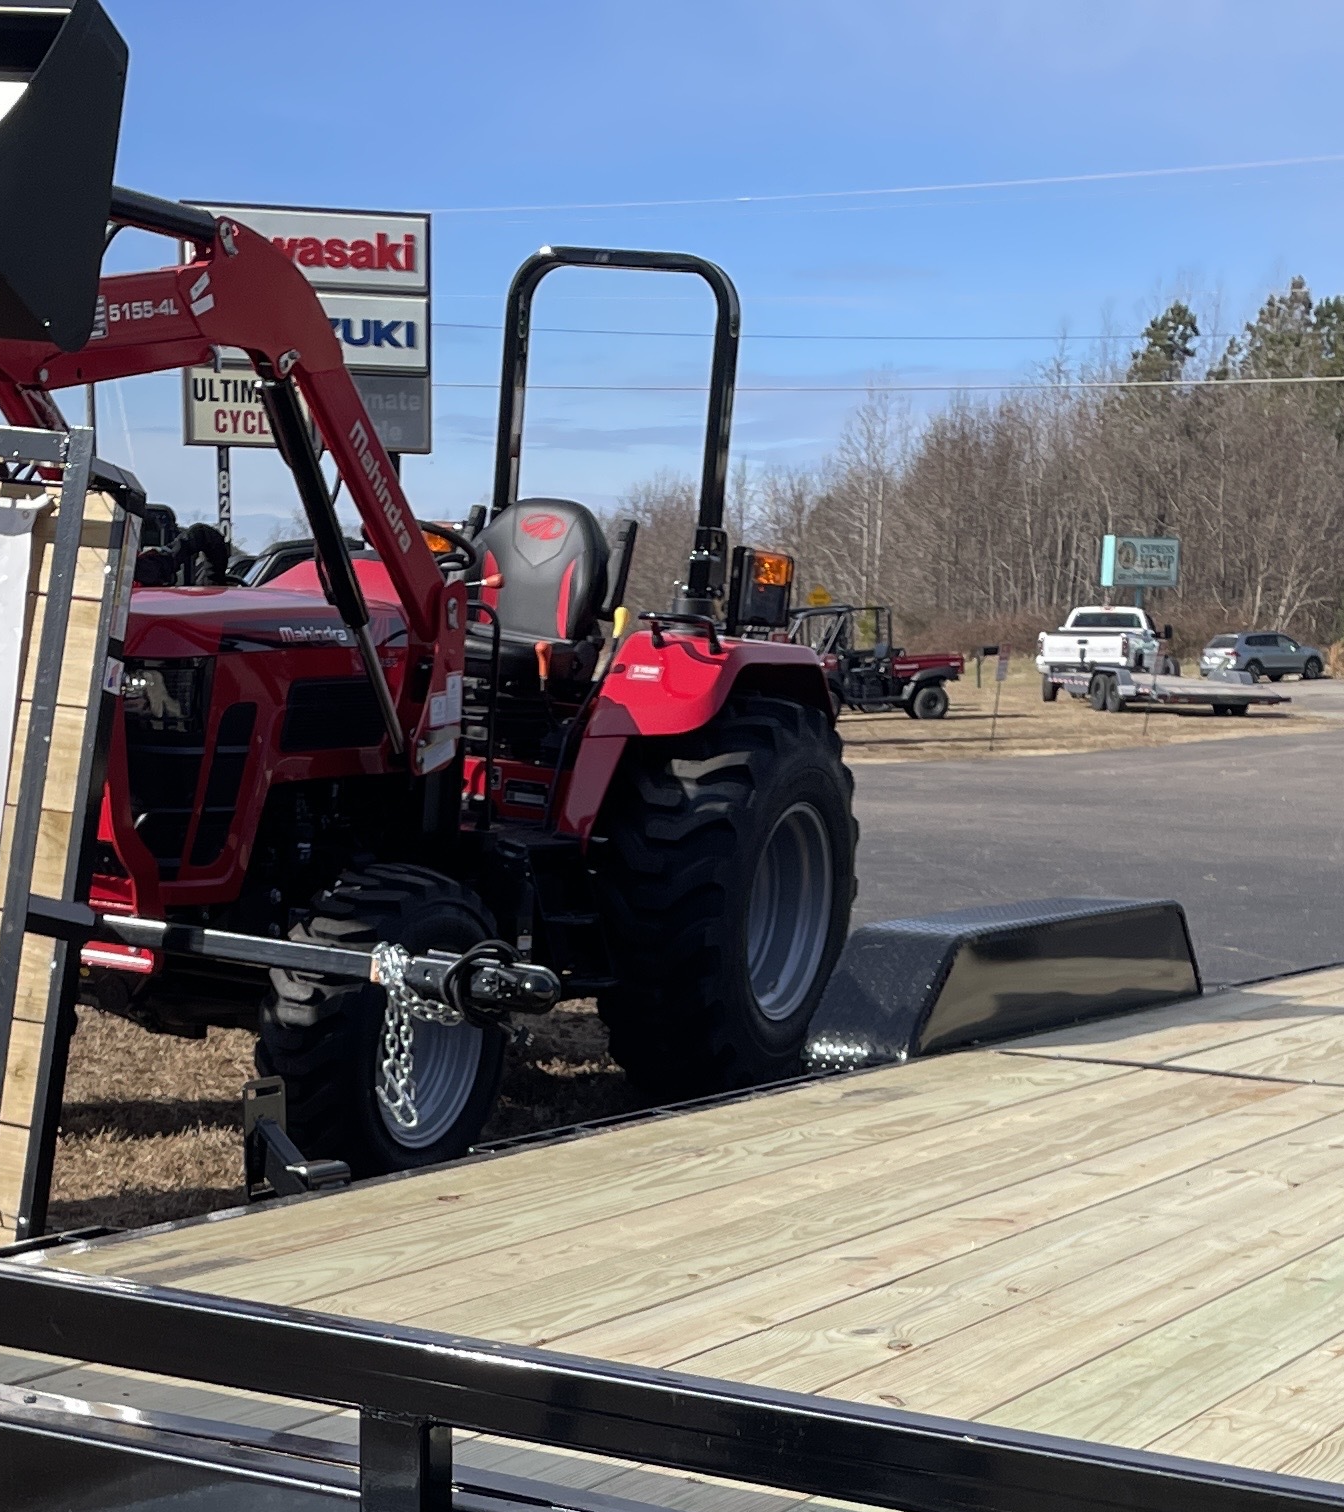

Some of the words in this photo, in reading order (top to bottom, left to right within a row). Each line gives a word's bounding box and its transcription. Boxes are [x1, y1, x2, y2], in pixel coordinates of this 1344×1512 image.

[109, 298, 179, 322] 5155-4L
[192, 377, 263, 403] ULTIM
[214, 408, 273, 435] CYCL
[348, 419, 412, 555] Mahindra
[278, 625, 348, 643] Mahindra
